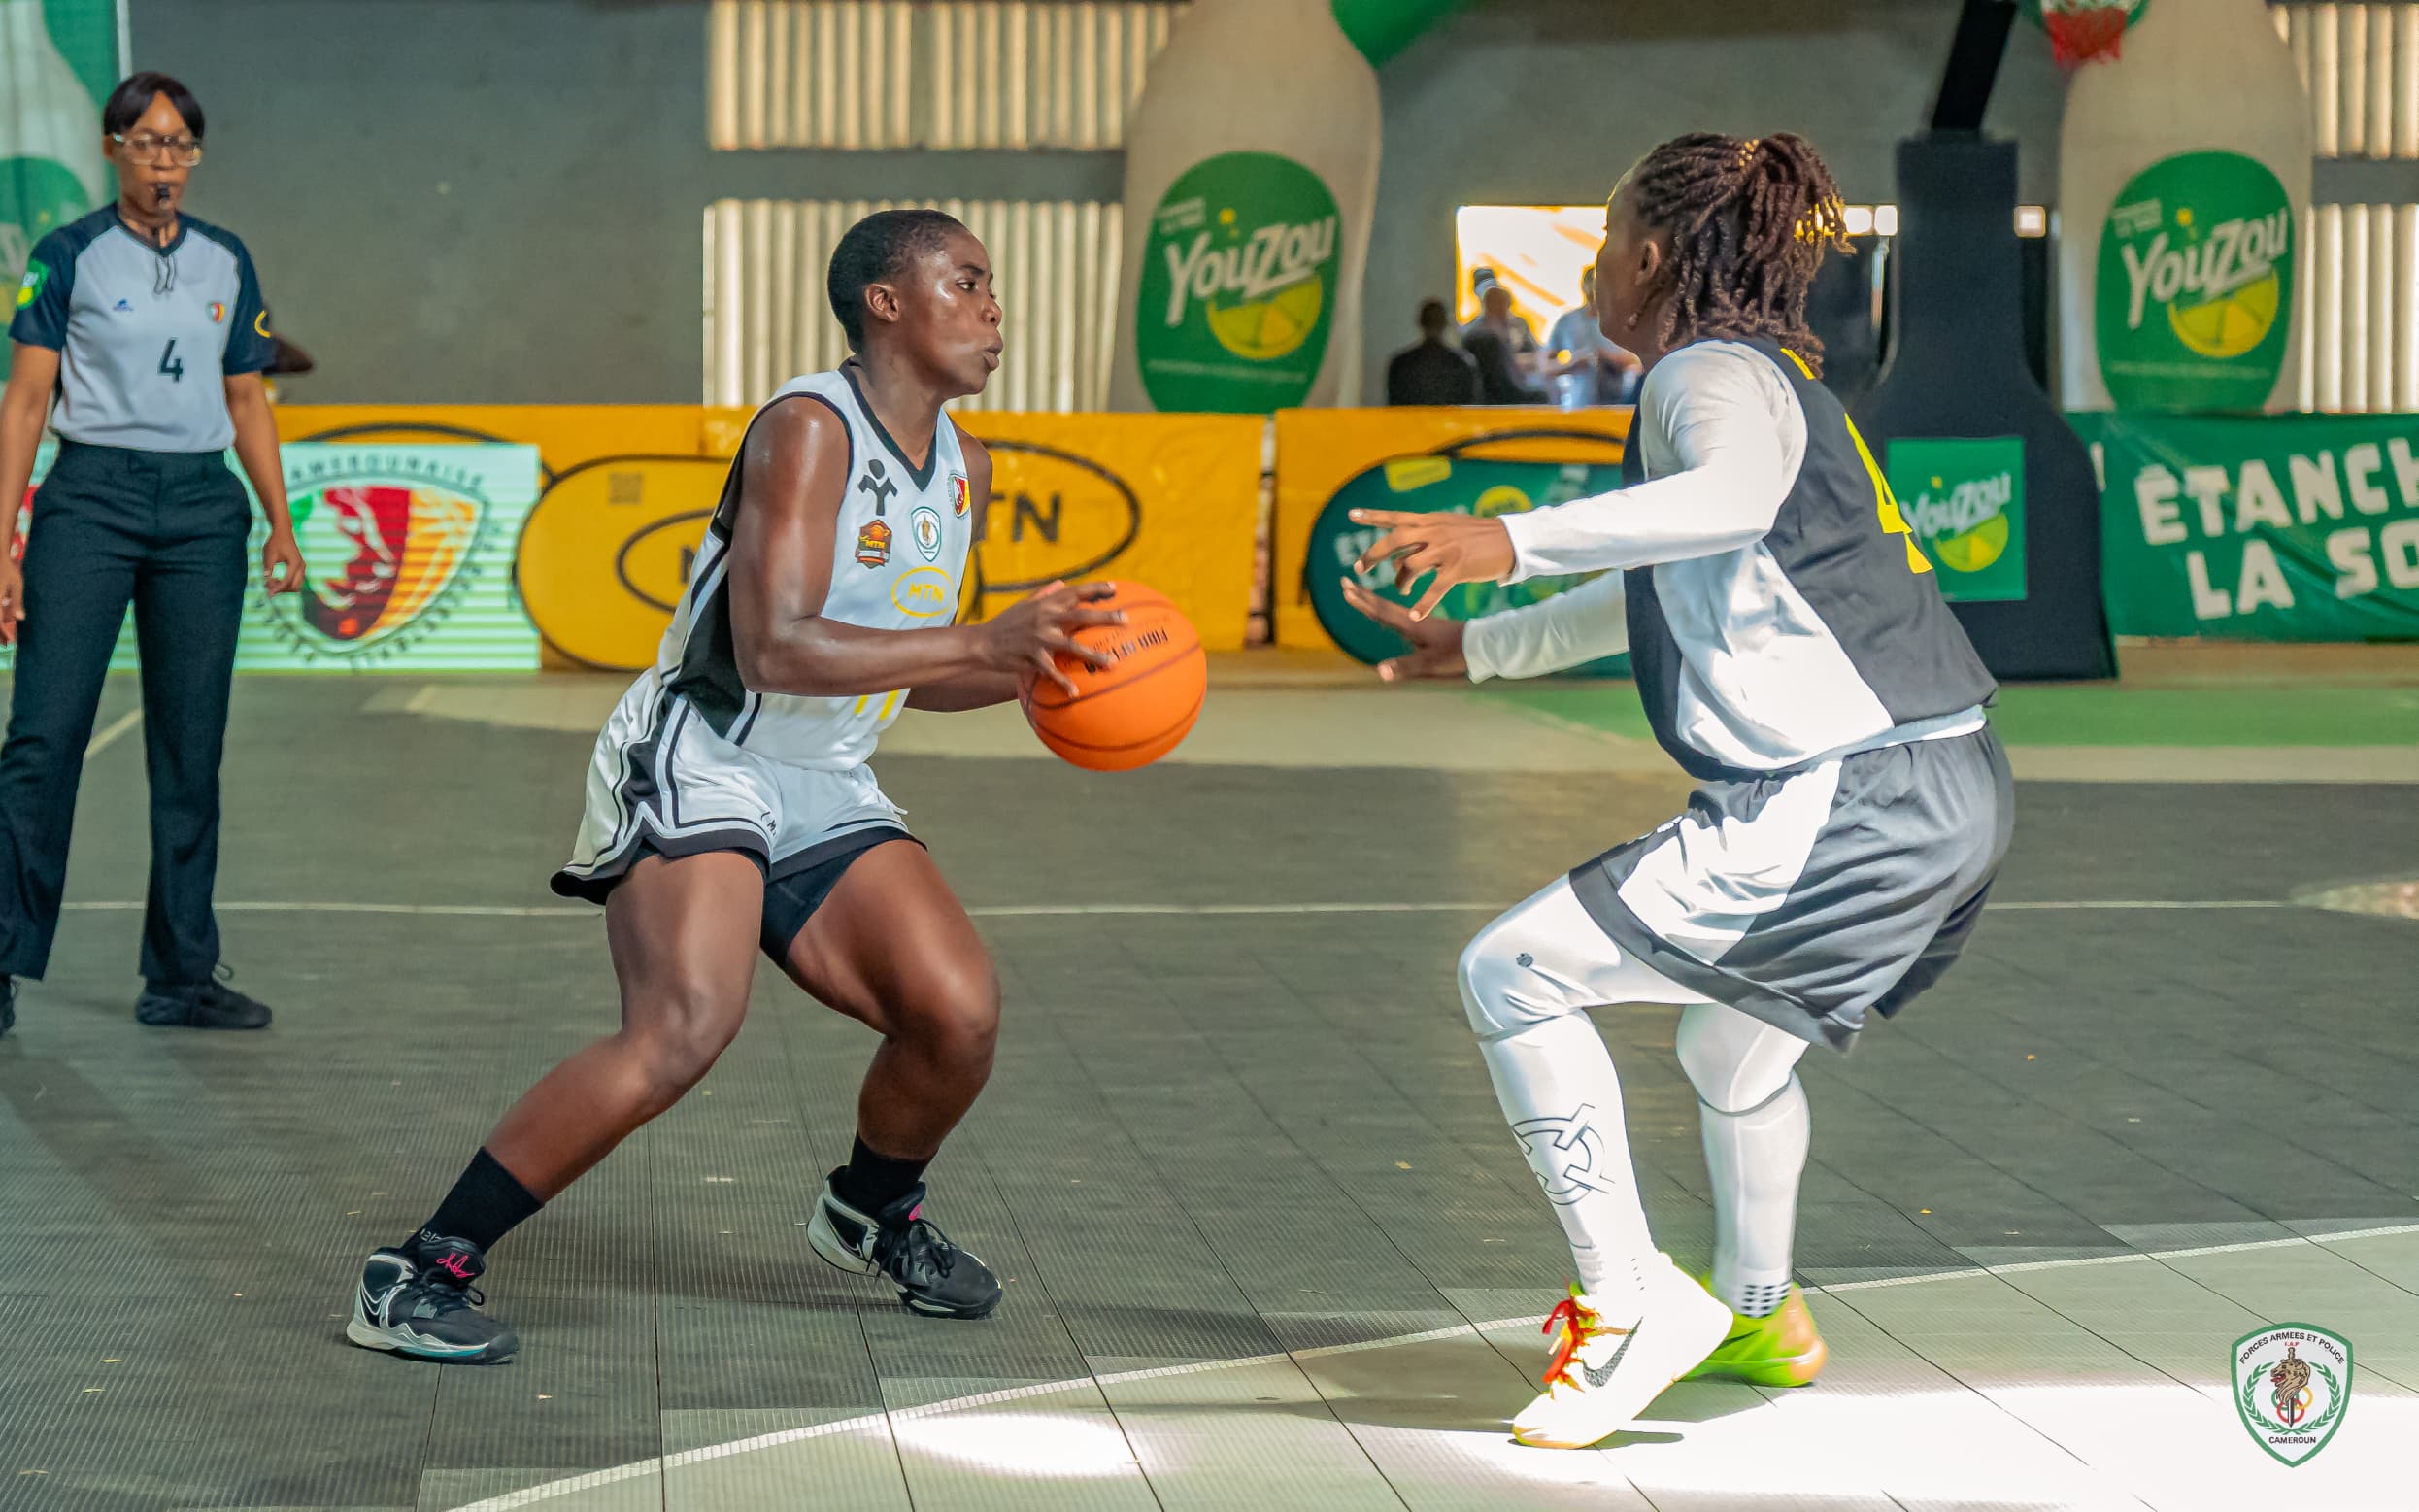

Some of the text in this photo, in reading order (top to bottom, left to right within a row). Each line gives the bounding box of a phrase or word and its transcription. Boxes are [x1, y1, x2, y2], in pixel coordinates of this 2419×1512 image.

[158, 338, 183, 383] 4
[906, 583, 946, 603] MTN
[2187, 539, 2294, 620] LA
